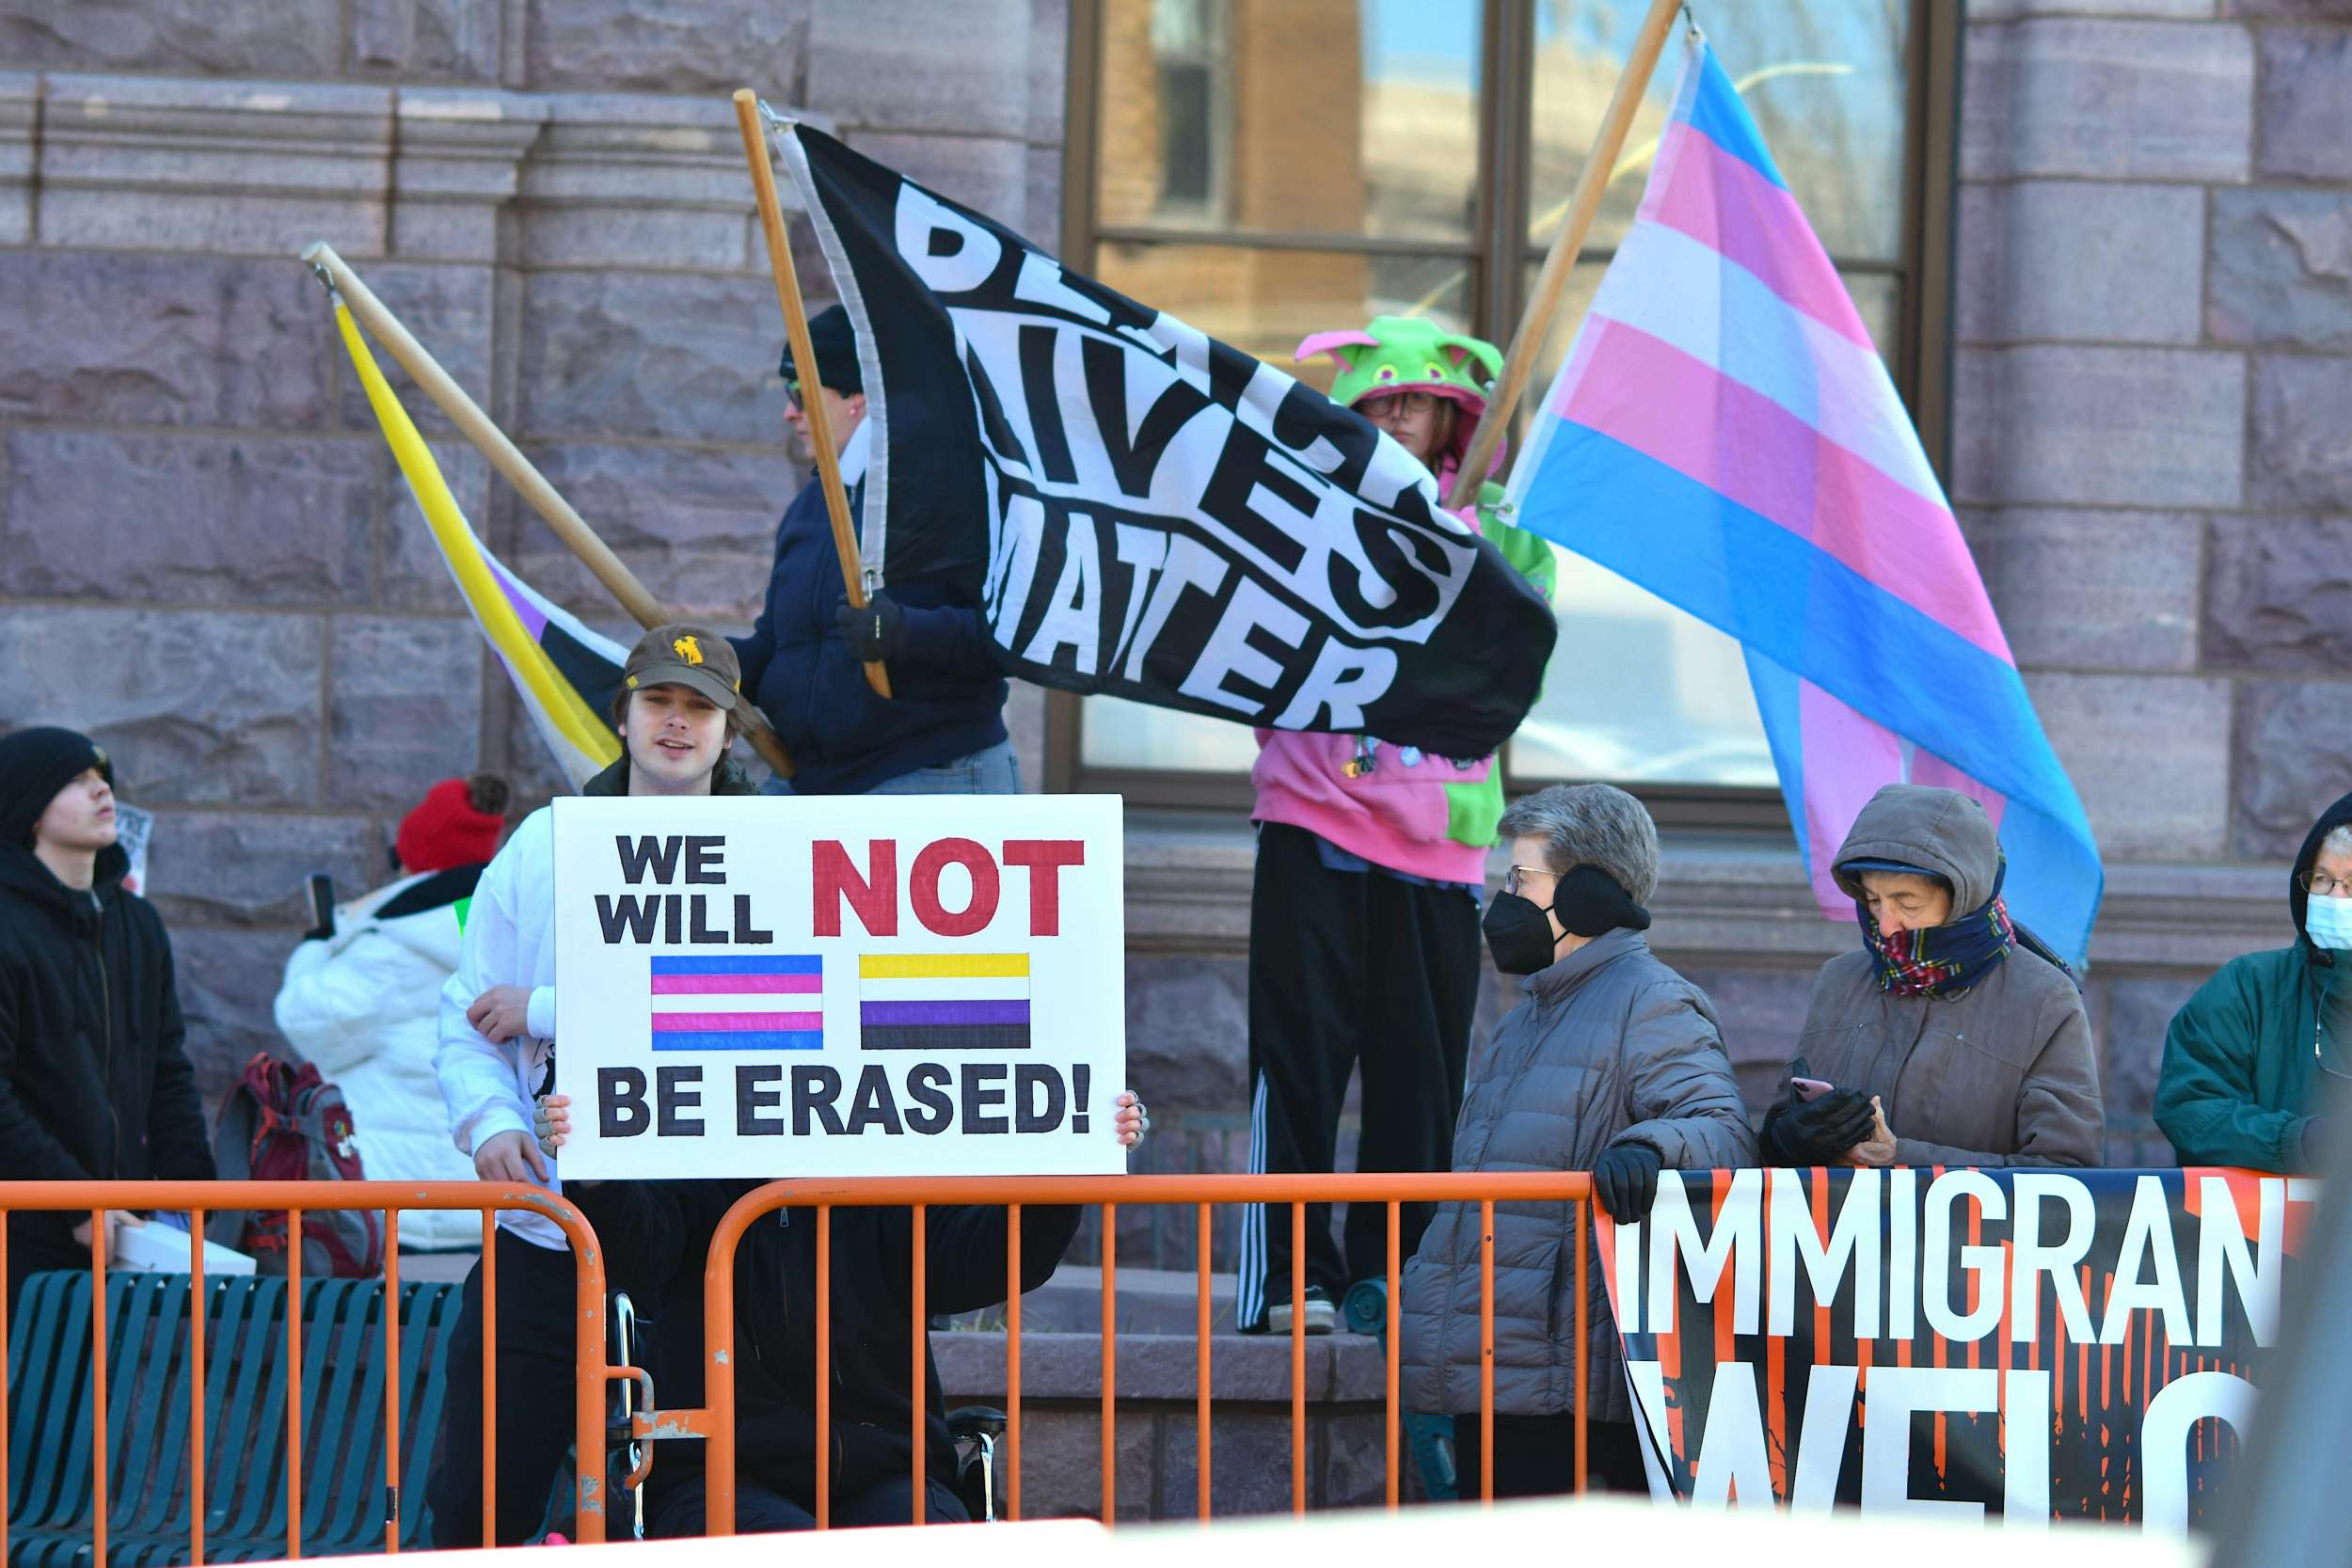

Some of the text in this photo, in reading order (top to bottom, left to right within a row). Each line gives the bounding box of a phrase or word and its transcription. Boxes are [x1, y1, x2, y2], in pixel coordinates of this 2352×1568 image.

[966, 323, 1452, 629] LIVES
[982, 457, 1399, 731] MATTER
[616, 835, 726, 885] WE
[812, 837, 1085, 937] NOT
[595, 895, 773, 944] WILL
[597, 1063, 1090, 1137] BE ERASED!
[1614, 1168, 2322, 1348] IMMIGRAN
